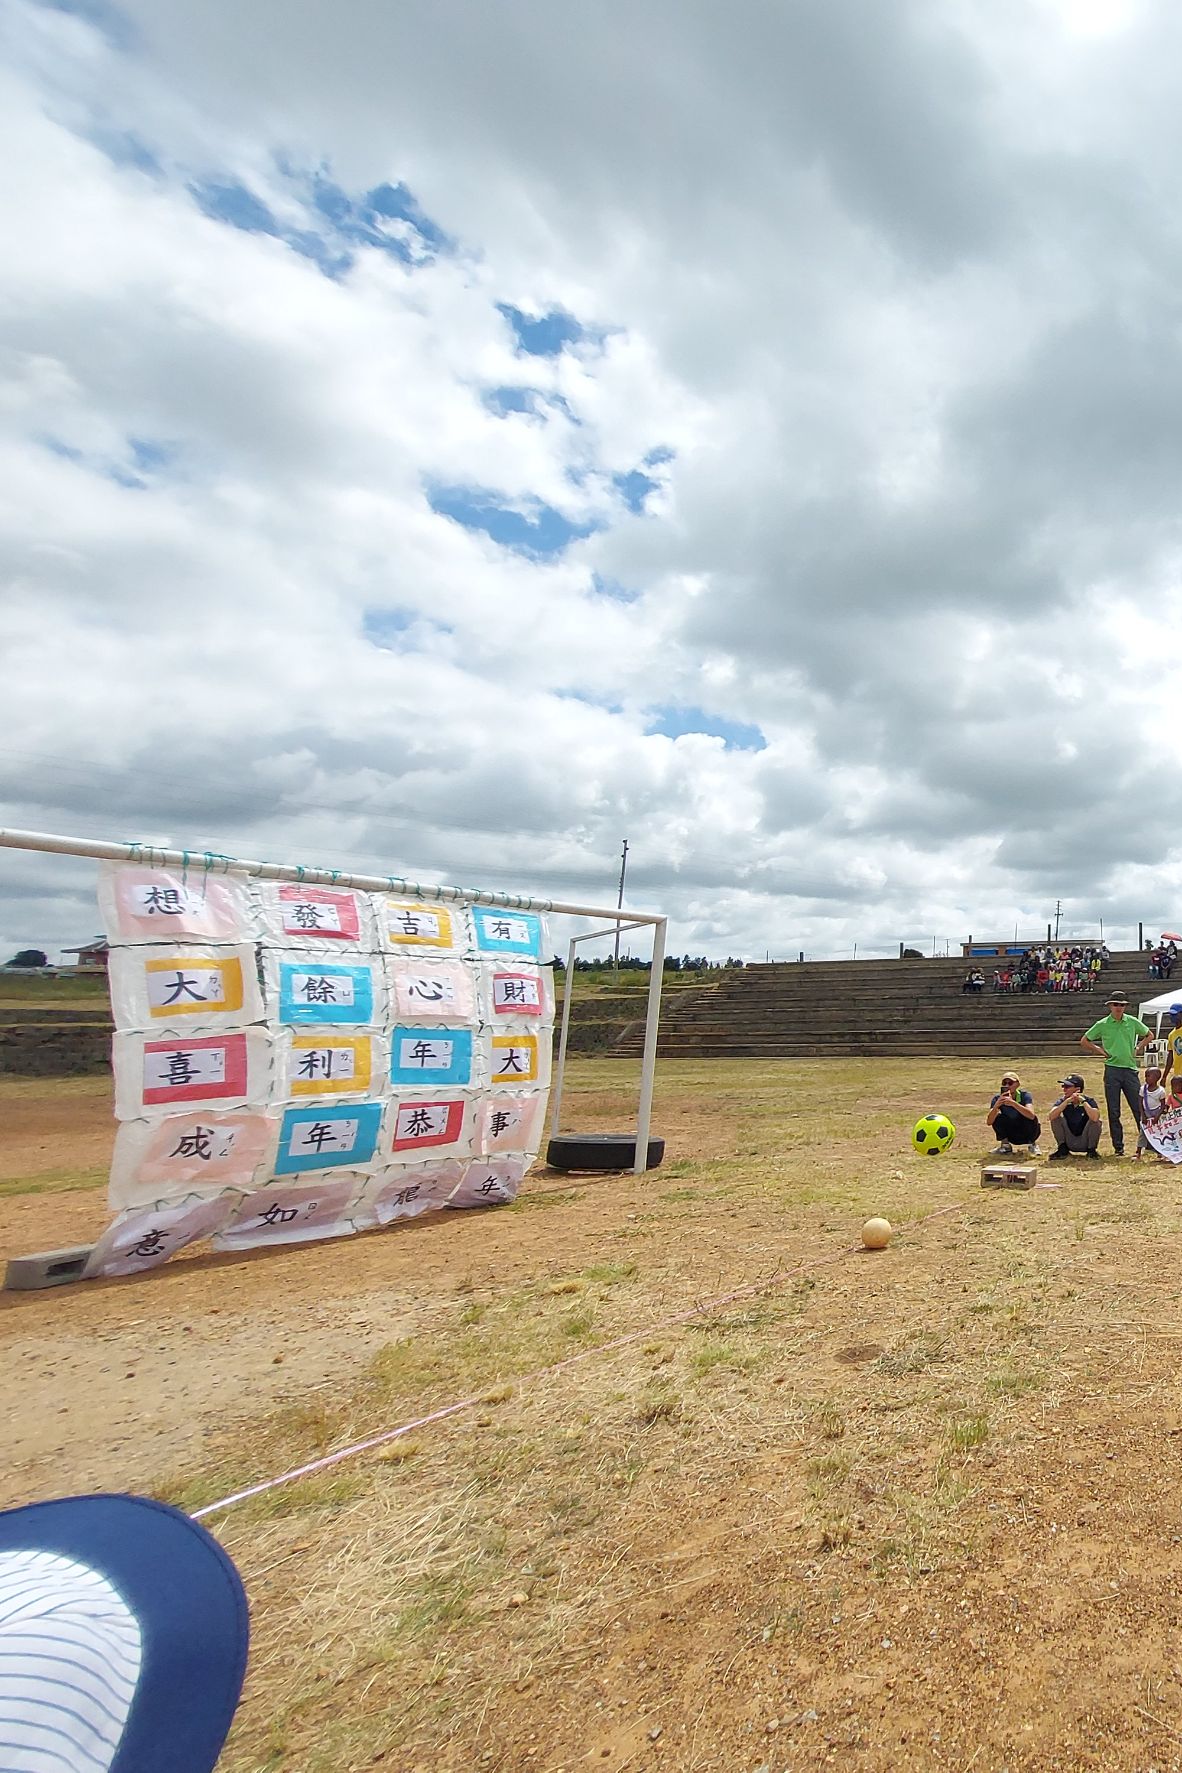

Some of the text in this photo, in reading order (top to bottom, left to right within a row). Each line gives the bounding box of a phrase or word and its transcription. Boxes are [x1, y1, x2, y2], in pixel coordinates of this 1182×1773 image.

[144, 886, 186, 915] 想
[292, 904, 324, 929] 發
[397, 911, 420, 935] 吉
[492, 921, 512, 940] 有
[161, 971, 208, 1005] 大
[301, 977, 337, 1004] 餘
[408, 980, 443, 1001] 心
[503, 980, 526, 1003] 財
[298, 1049, 333, 1079] 利
[408, 1040, 437, 1068] 年
[498, 1048, 523, 1074] 大
[158, 1051, 202, 1085] 喜
[404, 1108, 435, 1137] 恭
[490, 1111, 511, 1138] 事
[168, 1125, 215, 1160] 成
[301, 1122, 338, 1153] 年
[474, 1175, 501, 1196] 年
[255, 1202, 299, 1228] 如
[125, 1229, 170, 1257] 意
